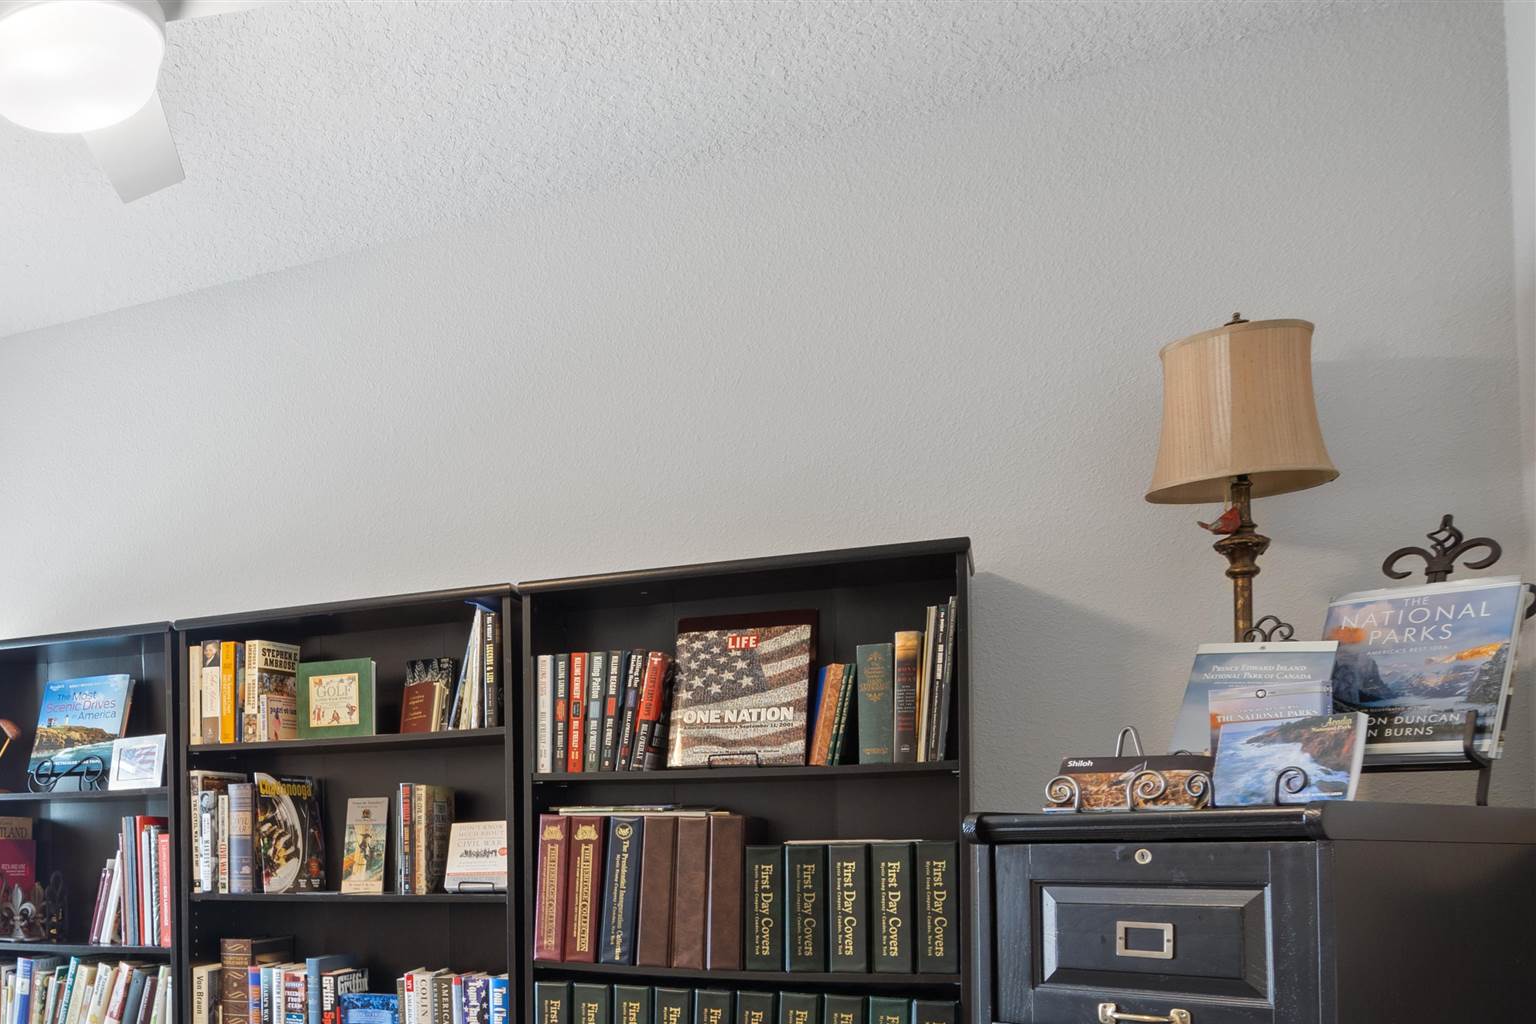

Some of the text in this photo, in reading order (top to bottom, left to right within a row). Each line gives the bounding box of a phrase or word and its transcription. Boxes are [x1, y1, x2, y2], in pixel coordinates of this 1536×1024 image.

[1404, 596, 1430, 606] THE
[1341, 601, 1491, 630] NATIONAL
[728, 635, 758, 649] LIFE
[1368, 624, 1453, 646] PARKS
[262, 648, 292, 661] STEPHEN
[264, 658, 296, 671] AMBROSE
[574, 657, 582, 675] KILLING
[591, 656, 602, 677] Killing
[610, 656, 618, 675] KILLING
[634, 655, 642, 676] Killing
[72, 690, 96, 700] Most
[317, 684, 352, 698] GOLF
[591, 678, 601, 699] Patton
[609, 676, 617, 695] REAGAN
[46, 700, 116, 713] Scenic Drives
[78, 710, 116, 720] America
[683, 707, 794, 724] ONE NATION
[1217, 709, 1319, 723] THE NATIONAL PARKS
[1322, 718, 1352, 727] Acadia
[1394, 713, 1461, 726] DUNCAN
[637, 724, 648, 760] BILL O'REILLY
[1384, 726, 1434, 737] BURNS
[581, 844, 593, 863] THE
[546, 864, 557, 902] HERITAGE
[578, 864, 591, 902] HERITAGE
[613, 840, 630, 960] The Presidential Collection
[760, 865, 774, 956] First Day Covers
[803, 864, 816, 956] First Day Covers
[842, 862, 856, 956] First Day Covers
[885, 862, 902, 956] First Day Covers
[931, 861, 948, 956] First Day Covers
[577, 903, 589, 952] COLLECTION
[338, 970, 368, 994] Griffin
[468, 982, 481, 1000] Tom
[196, 992, 204, 1014] Braun
[322, 976, 334, 1010] Griffin
[420, 979, 428, 1016] COLIN
[493, 987, 505, 1005] Tom
[550, 1000, 560, 1024] First
